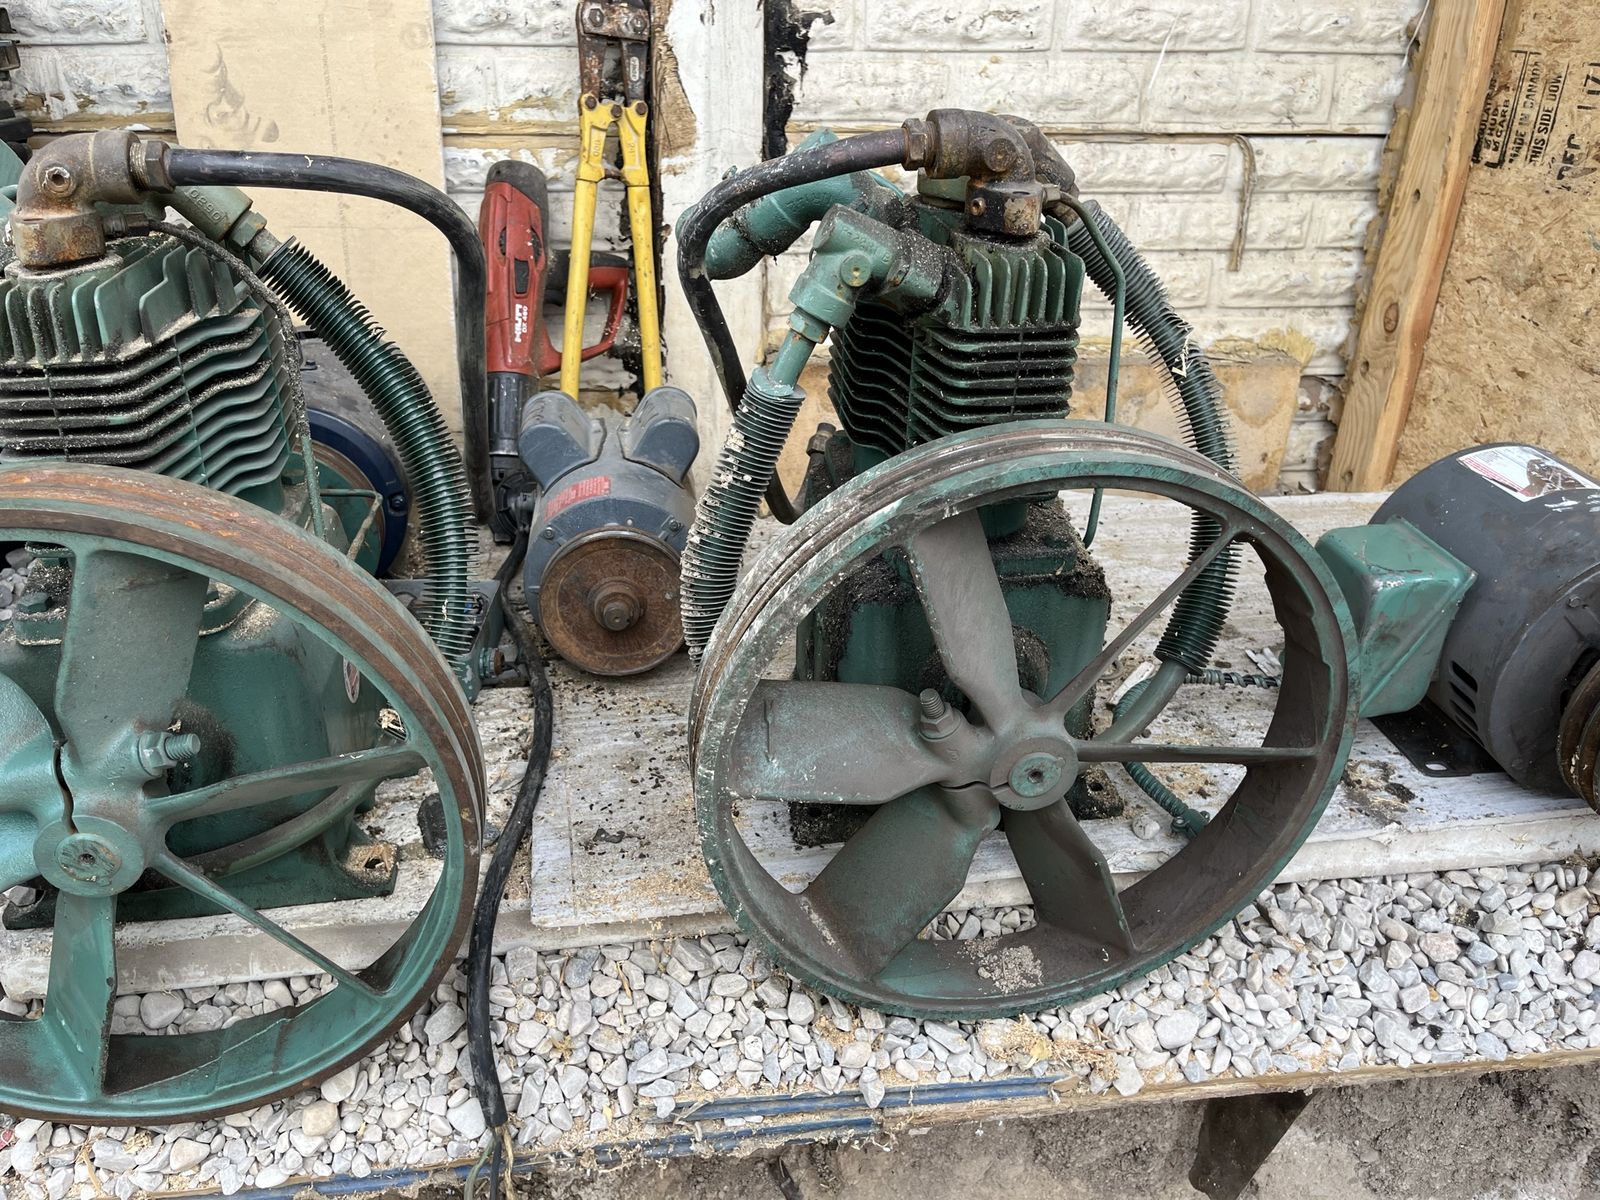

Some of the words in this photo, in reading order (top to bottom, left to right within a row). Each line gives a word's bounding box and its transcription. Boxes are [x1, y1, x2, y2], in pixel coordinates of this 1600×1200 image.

[1529, 139, 1545, 163] THIS
[1537, 106, 1554, 136] SIDE
[514, 303, 522, 343] HILTI
